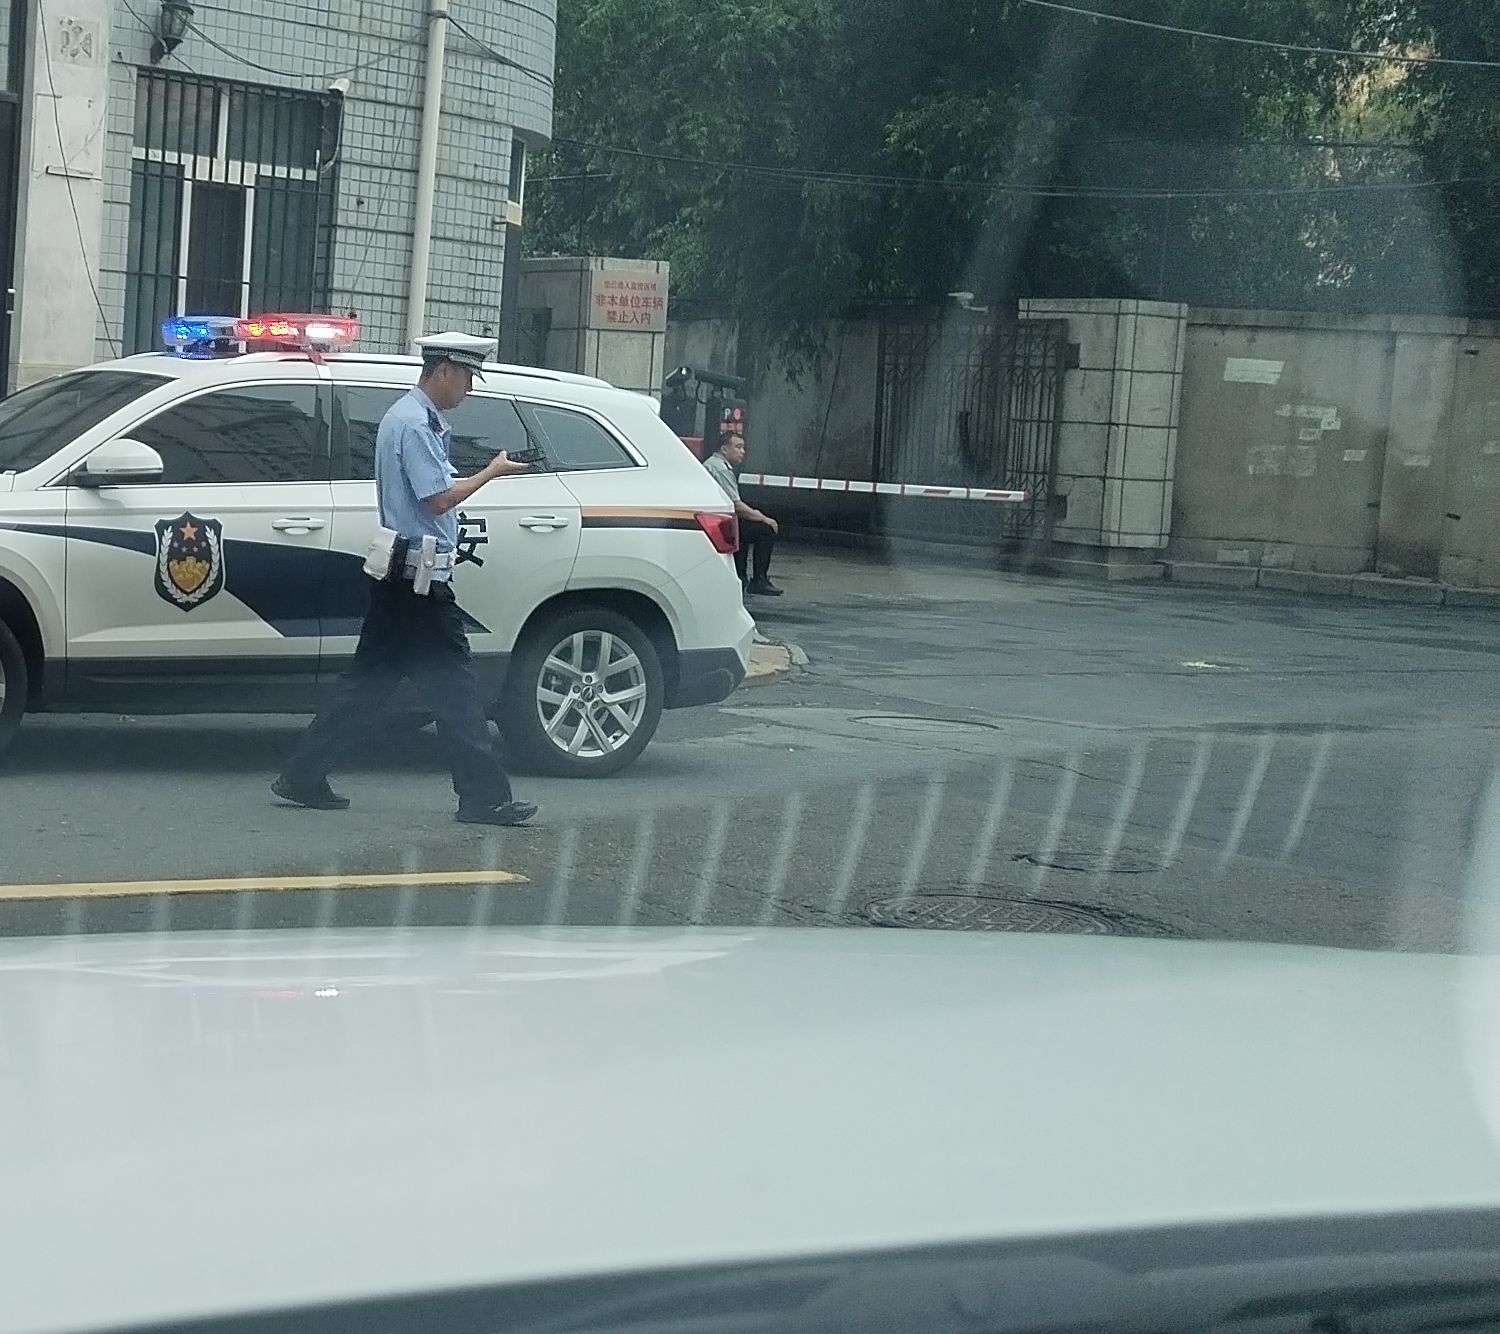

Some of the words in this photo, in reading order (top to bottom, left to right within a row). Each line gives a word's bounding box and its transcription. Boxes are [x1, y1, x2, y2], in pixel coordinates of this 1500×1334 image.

[595, 293, 664, 310] 非本单位车辆
[606, 309, 651, 324] 禁止入内
[724, 408, 731, 420] P
